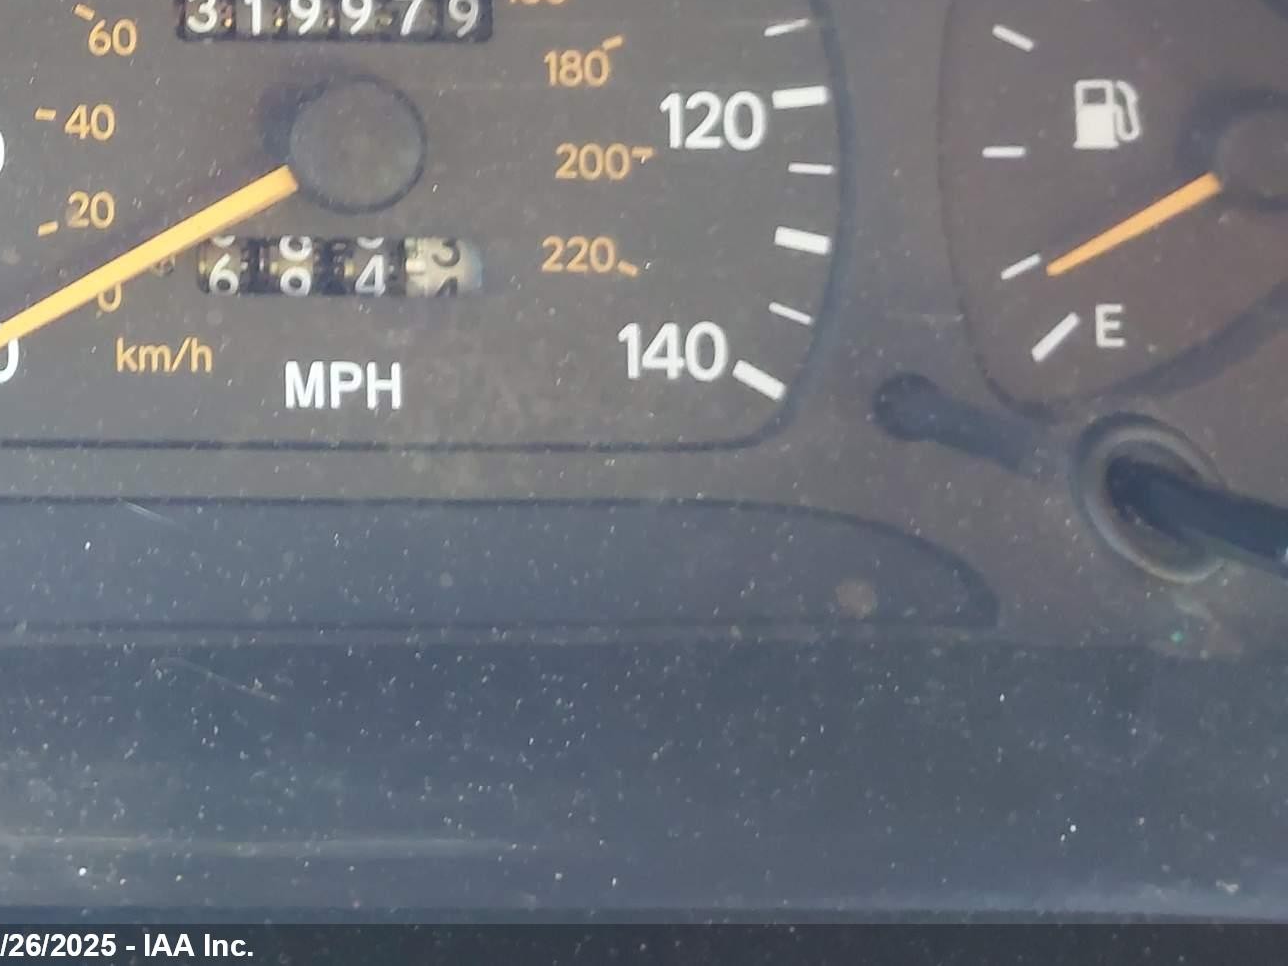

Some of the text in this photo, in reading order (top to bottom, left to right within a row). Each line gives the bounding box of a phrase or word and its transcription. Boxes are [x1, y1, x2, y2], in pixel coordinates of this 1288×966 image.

[88, 18, 137, 56] 60
[544, 49, 610, 87] 180
[64, 104, 115, 141] 40
[659, 91, 766, 151] 120
[555, 143, 631, 180] 200
[68, 191, 115, 228] 20
[541, 235, 616, 273] 220
[1095, 303, 1125, 348] E
[116, 337, 213, 373] km/h
[618, 321, 728, 381] 140
[285, 360, 402, 410] MPH
